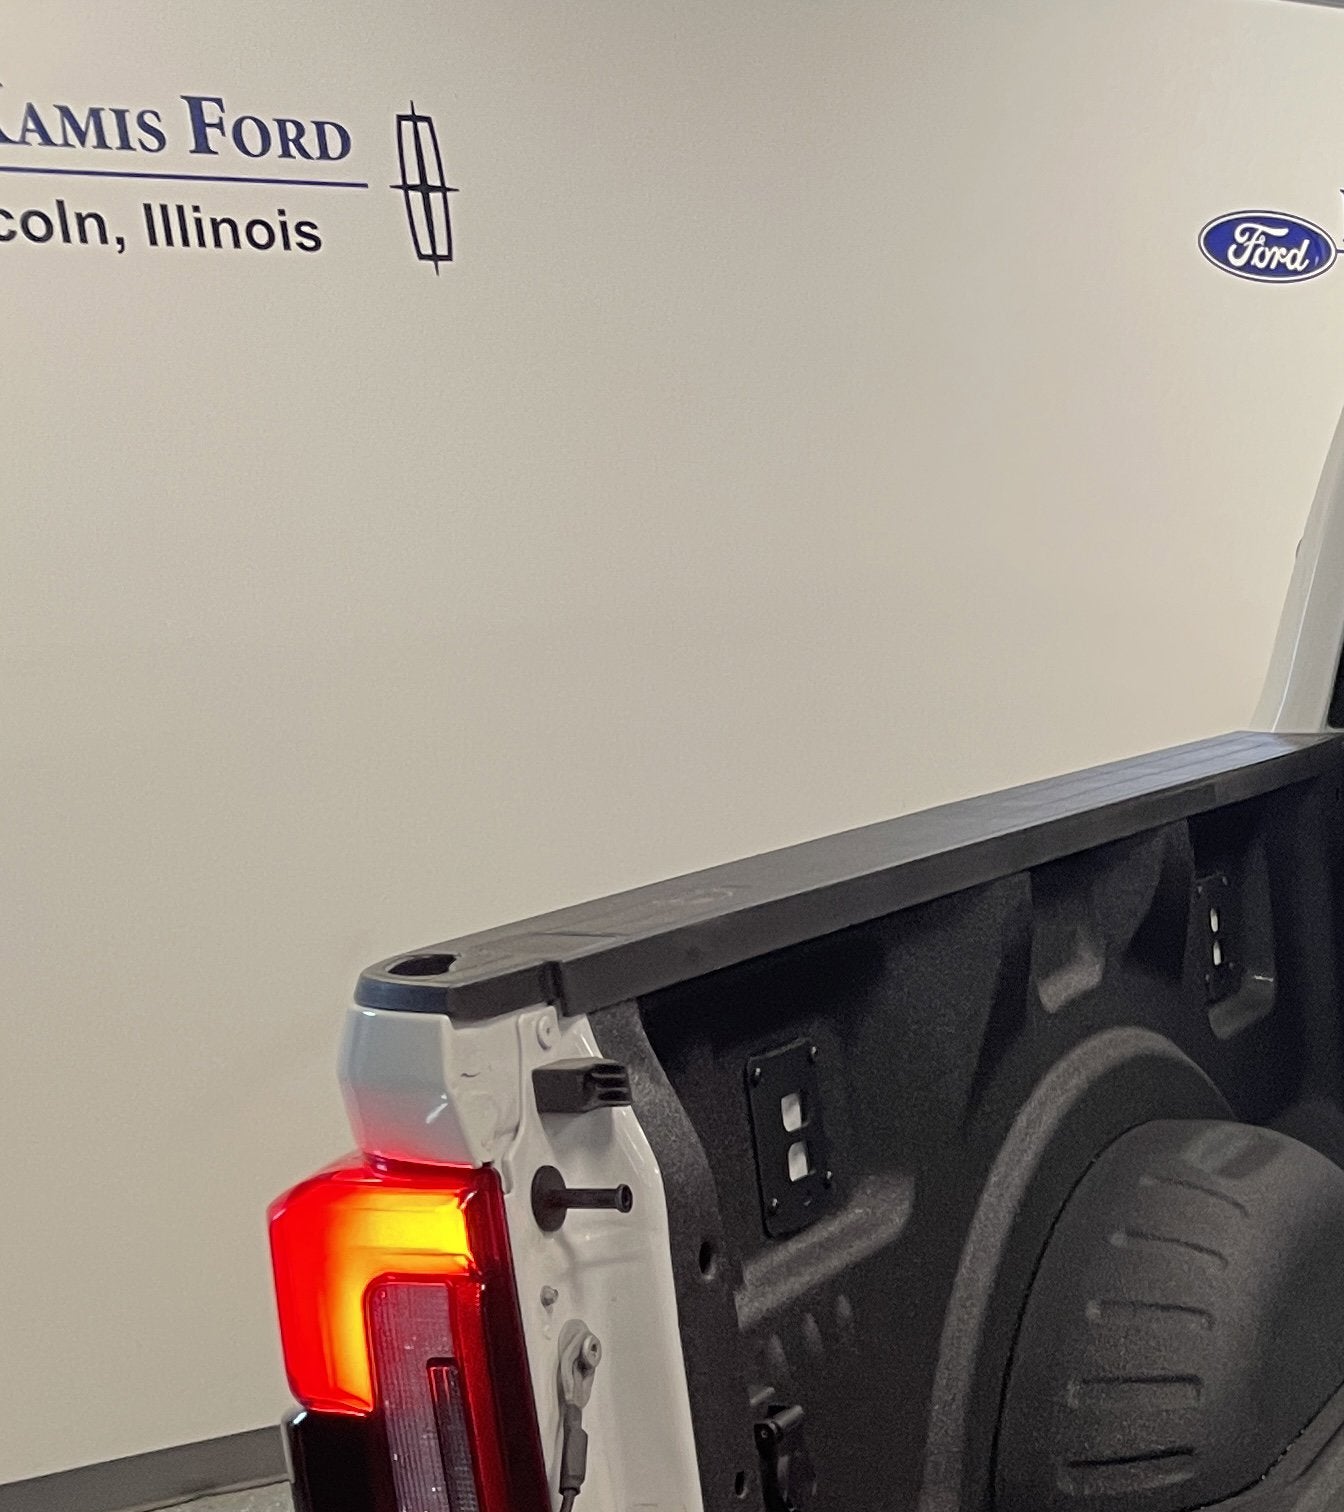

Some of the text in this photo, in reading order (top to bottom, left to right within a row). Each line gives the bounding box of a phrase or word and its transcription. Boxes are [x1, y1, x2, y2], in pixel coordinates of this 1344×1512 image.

[0, 84, 352, 161] AMIS FORD
[142, 203, 323, 252] Illinois
[1227, 222, 1310, 271] Ford
